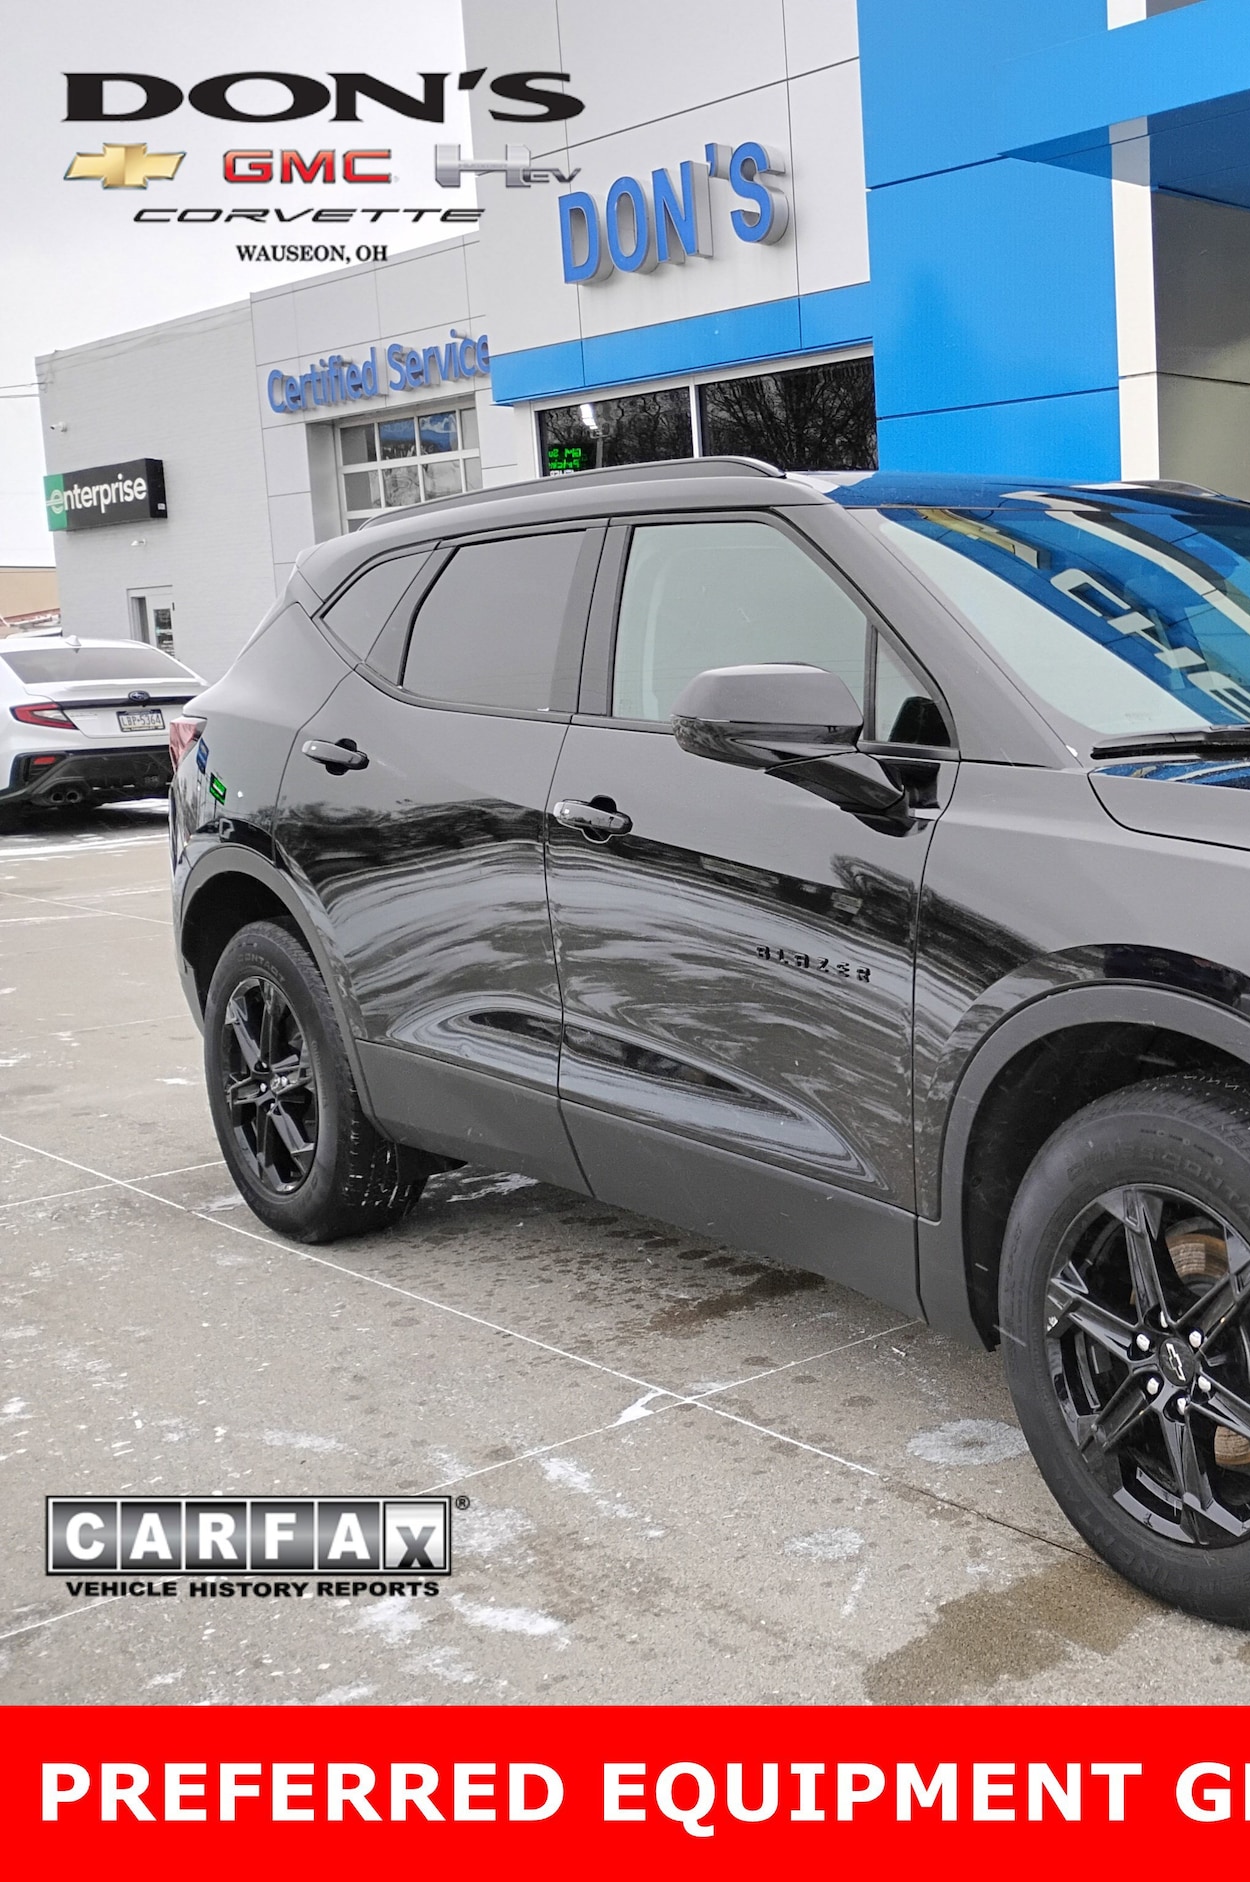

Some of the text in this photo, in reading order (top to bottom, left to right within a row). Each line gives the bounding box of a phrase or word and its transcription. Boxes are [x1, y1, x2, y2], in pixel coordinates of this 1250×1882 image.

[558, 142, 786, 284] DON'S
[267, 328, 491, 414] Certified Service
[46, 473, 147, 514] enterprise
[756, 945, 871, 983] BLAZER
